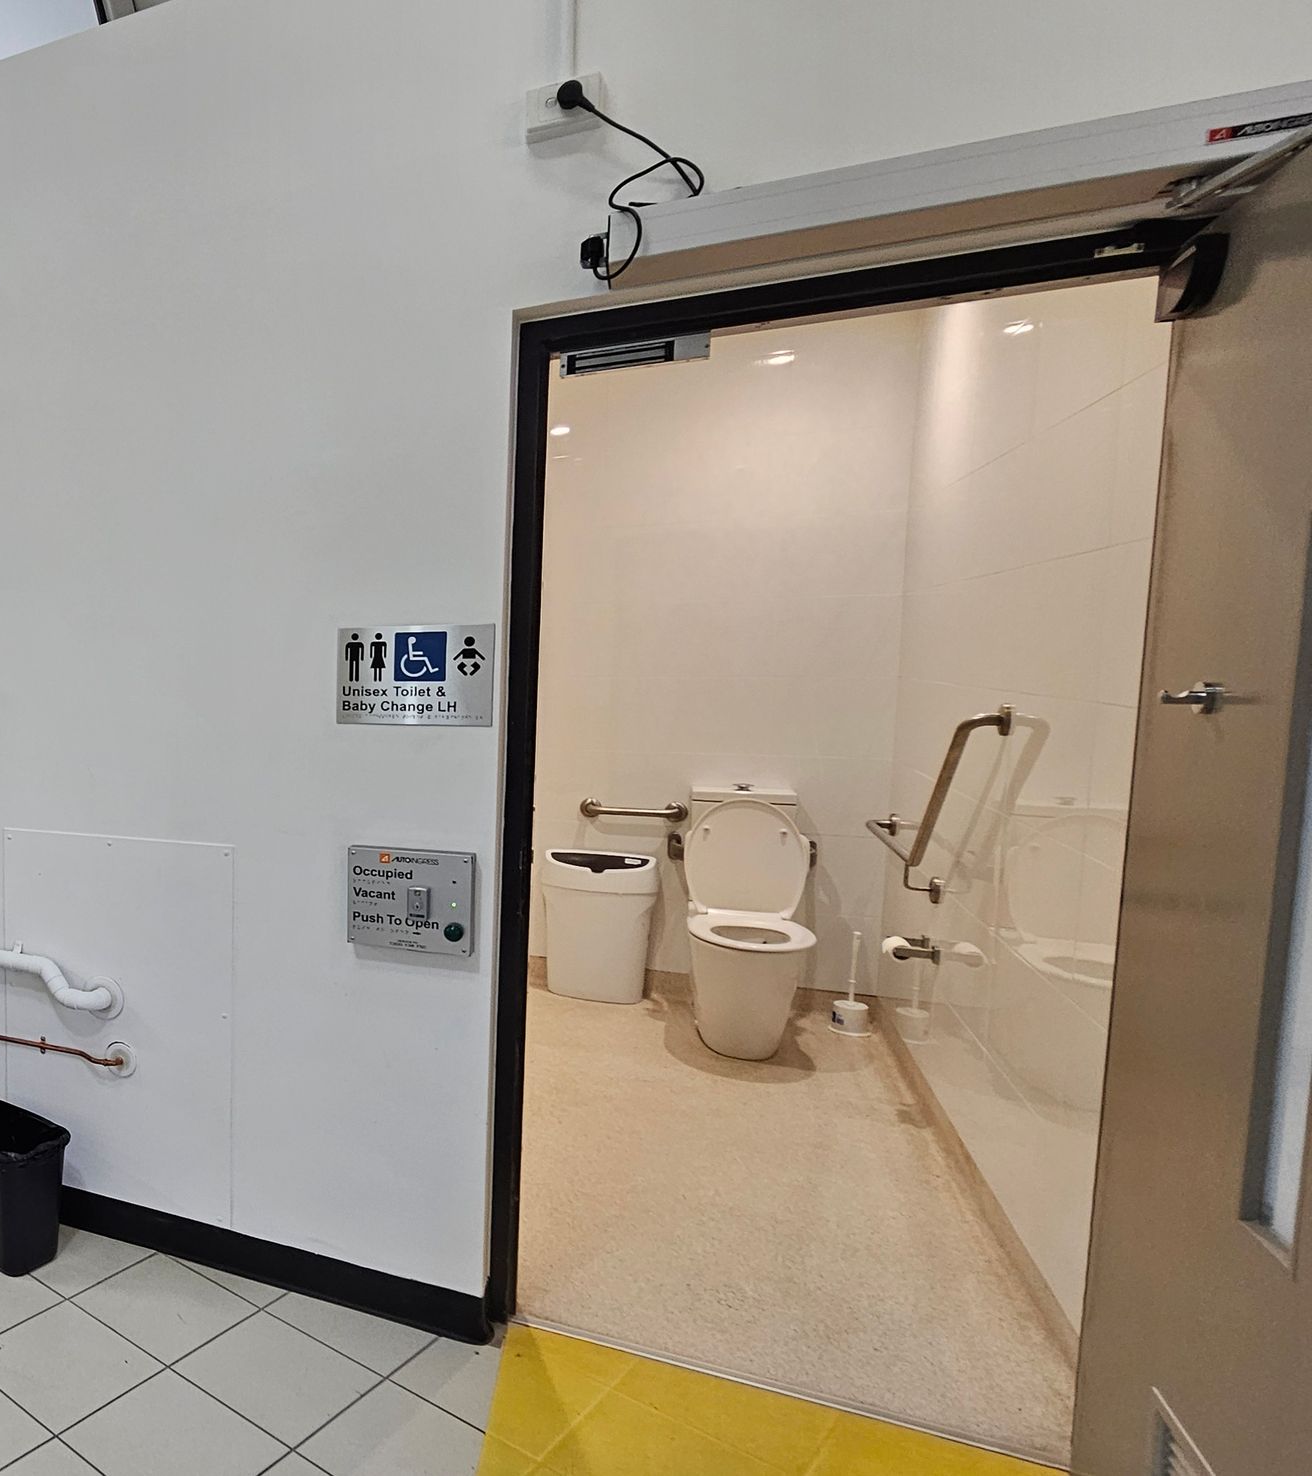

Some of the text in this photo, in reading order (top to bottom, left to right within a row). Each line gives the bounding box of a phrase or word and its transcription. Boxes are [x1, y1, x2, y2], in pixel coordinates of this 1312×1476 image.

[342, 686, 446, 697] Unisex Toilet &
[342, 701, 457, 715] Baby Change LH
[352, 865, 413, 880] Occupied
[353, 887, 396, 900] Vacant
[352, 911, 439, 933] Push To Open
